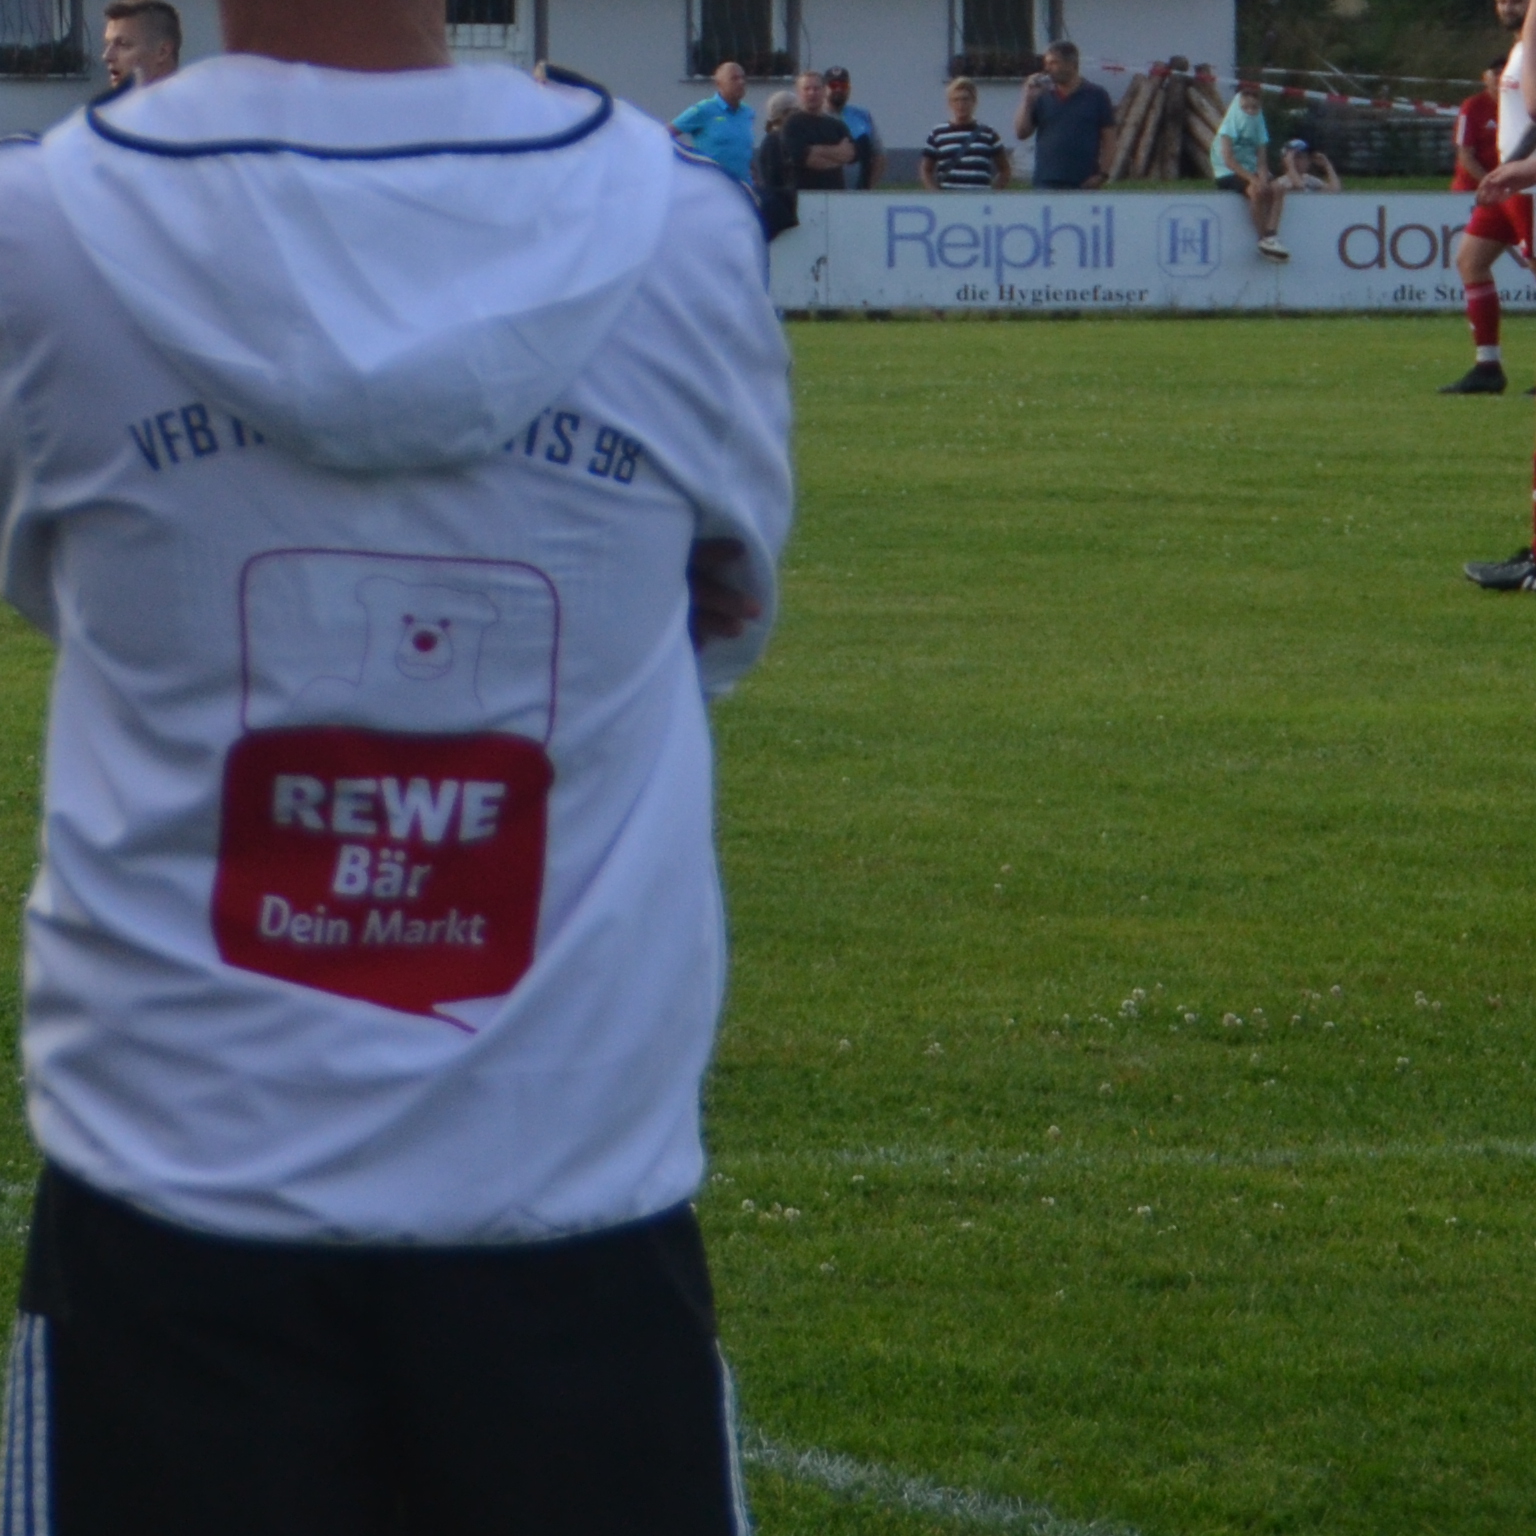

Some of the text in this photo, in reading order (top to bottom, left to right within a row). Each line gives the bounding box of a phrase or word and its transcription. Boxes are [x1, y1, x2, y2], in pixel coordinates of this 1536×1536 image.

[886, 205, 1115, 284] Reiphil
[956, 284, 1149, 305] die Hygienefaser
[1393, 284, 1426, 302] die
[129, 402, 219, 472] VFB
[587, 425, 649, 485] 98
[272, 773, 507, 844] REWE
[332, 843, 430, 899] Bär
[259, 893, 487, 946] Dein Markt
